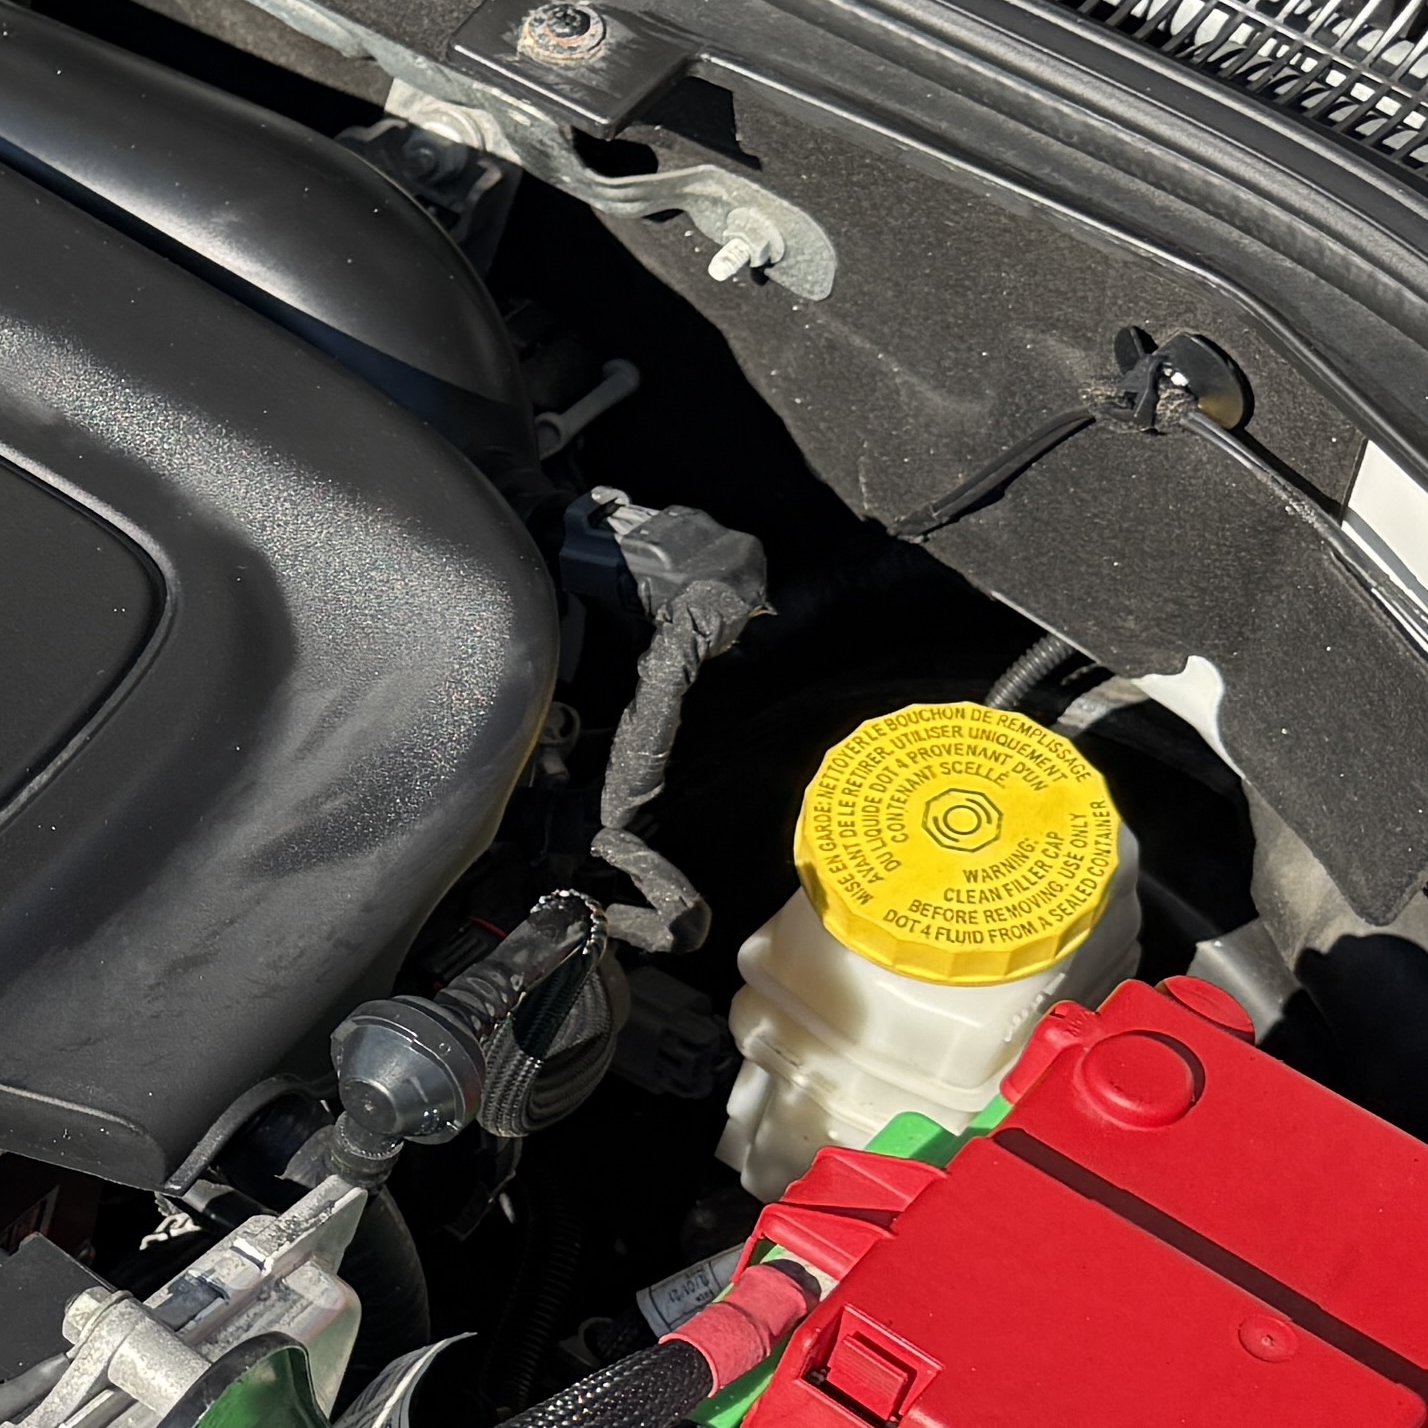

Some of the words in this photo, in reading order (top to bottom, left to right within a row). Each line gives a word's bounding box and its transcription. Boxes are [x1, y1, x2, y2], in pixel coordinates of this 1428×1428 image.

[862, 723, 888, 742] LE
[883, 707, 966, 732] BOUCHON
[970, 708, 993, 725] DE
[889, 724, 964, 750] UTILISER
[996, 714, 1091, 783] REMPLISSAGE
[816, 735, 871, 800] NETTOYER
[894, 757, 910, 769] 4
[905, 742, 1014, 766] PROVENANT
[968, 727, 1068, 782] UNIQUEMENT
[841, 746, 895, 798] RETIRER.
[868, 765, 900, 794] DOT
[1010, 761, 1049, 792] D'UN
[836, 799, 857, 817] LE
[885, 764, 937, 844] CONTENANT
[813, 801, 838, 852] GARDE:
[837, 820, 858, 839] DE
[861, 795, 888, 852] LIQUIDE
[1069, 813, 1089, 849] ONLY
[824, 854, 849, 874] EN
[842, 842, 885, 884] AVANT
[875, 851, 903, 873] DU
[882, 908, 921, 934] DOT
[919, 922, 932, 940] 4
[934, 926, 985, 945] FLUID
[987, 920, 1039, 944] FROM
[1037, 915, 1054, 931] A
[1048, 877, 1098, 923] SEALED
[1086, 800, 1113, 877] CONTAINER
[943, 886, 1004, 905] CLEAN
[1001, 859, 1054, 898] FILLER
[1040, 831, 1065, 860] CAP
[962, 837, 1039, 884] WARNING:
[1056, 851, 1085, 880] USE
[837, 872, 875, 906] MISE
[982, 880, 1069, 924] REMOVING.
[907, 899, 979, 925] BEFORE
